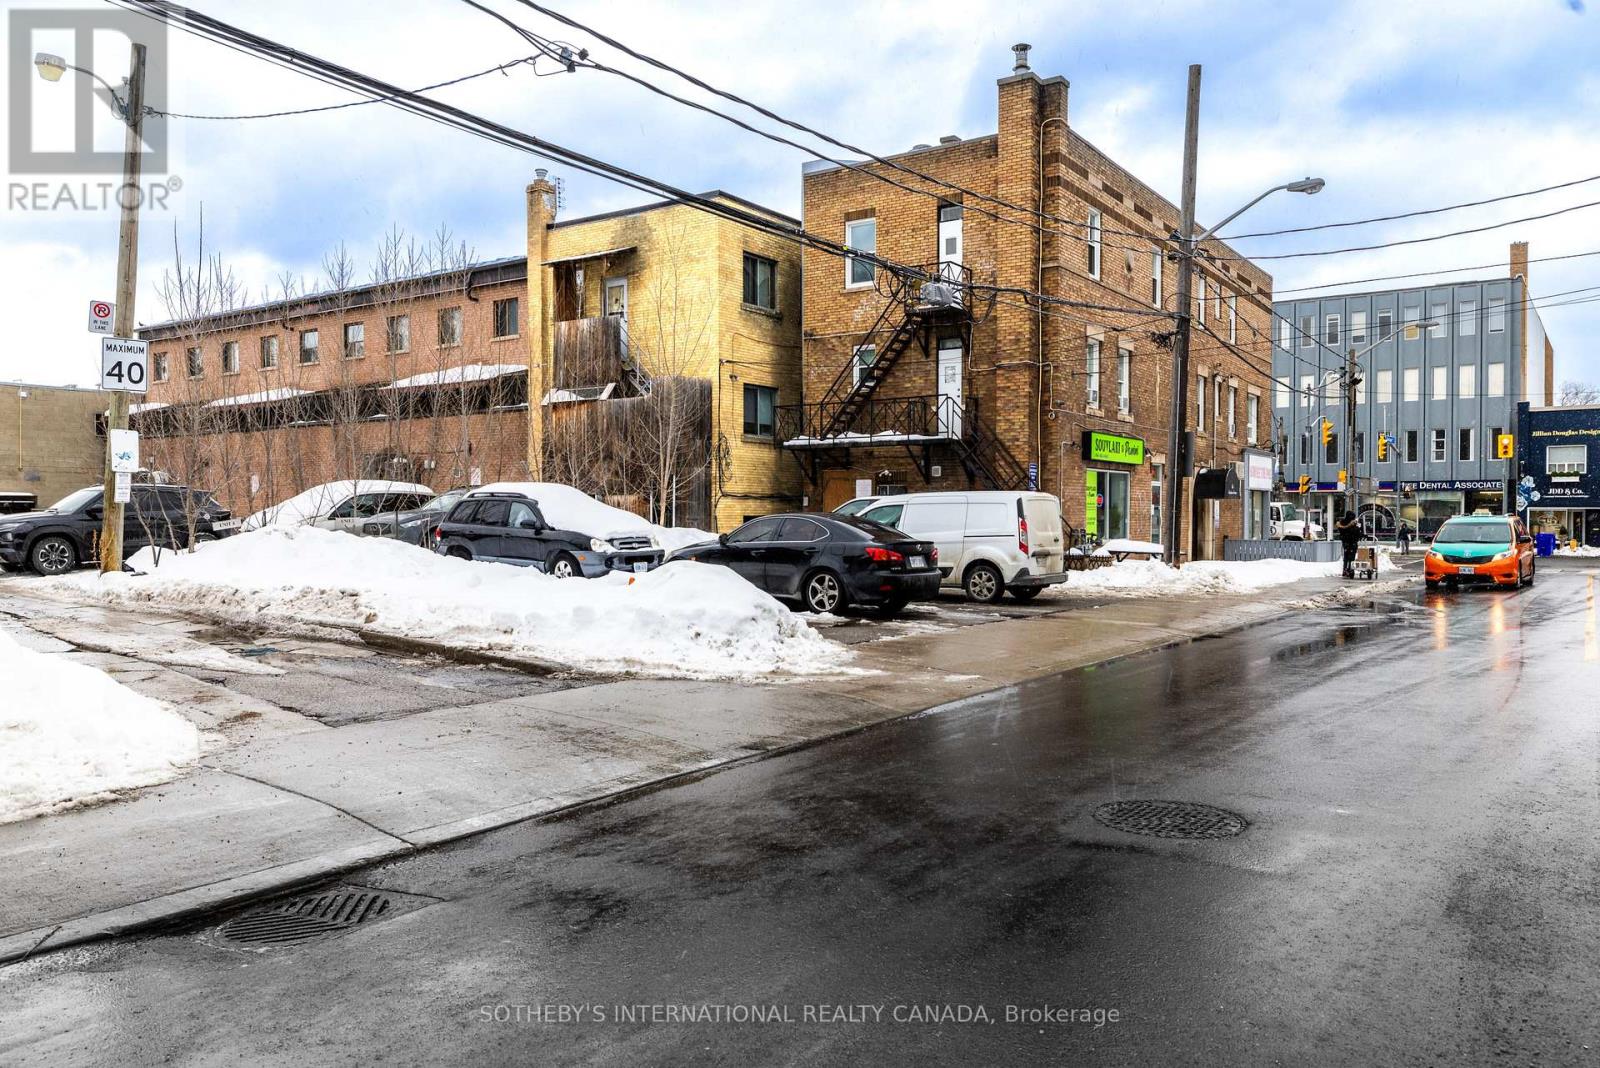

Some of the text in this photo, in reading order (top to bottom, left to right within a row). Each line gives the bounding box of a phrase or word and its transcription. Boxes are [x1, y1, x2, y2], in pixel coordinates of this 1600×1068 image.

[106, 343, 145, 354] MAXIMUM
[105, 360, 145, 385] 40
[1552, 429, 1578, 437] Douglas
[1419, 481, 1452, 489] DENTAL
[1564, 487, 1571, 496] &
[1571, 487, 1584, 495] Co.
